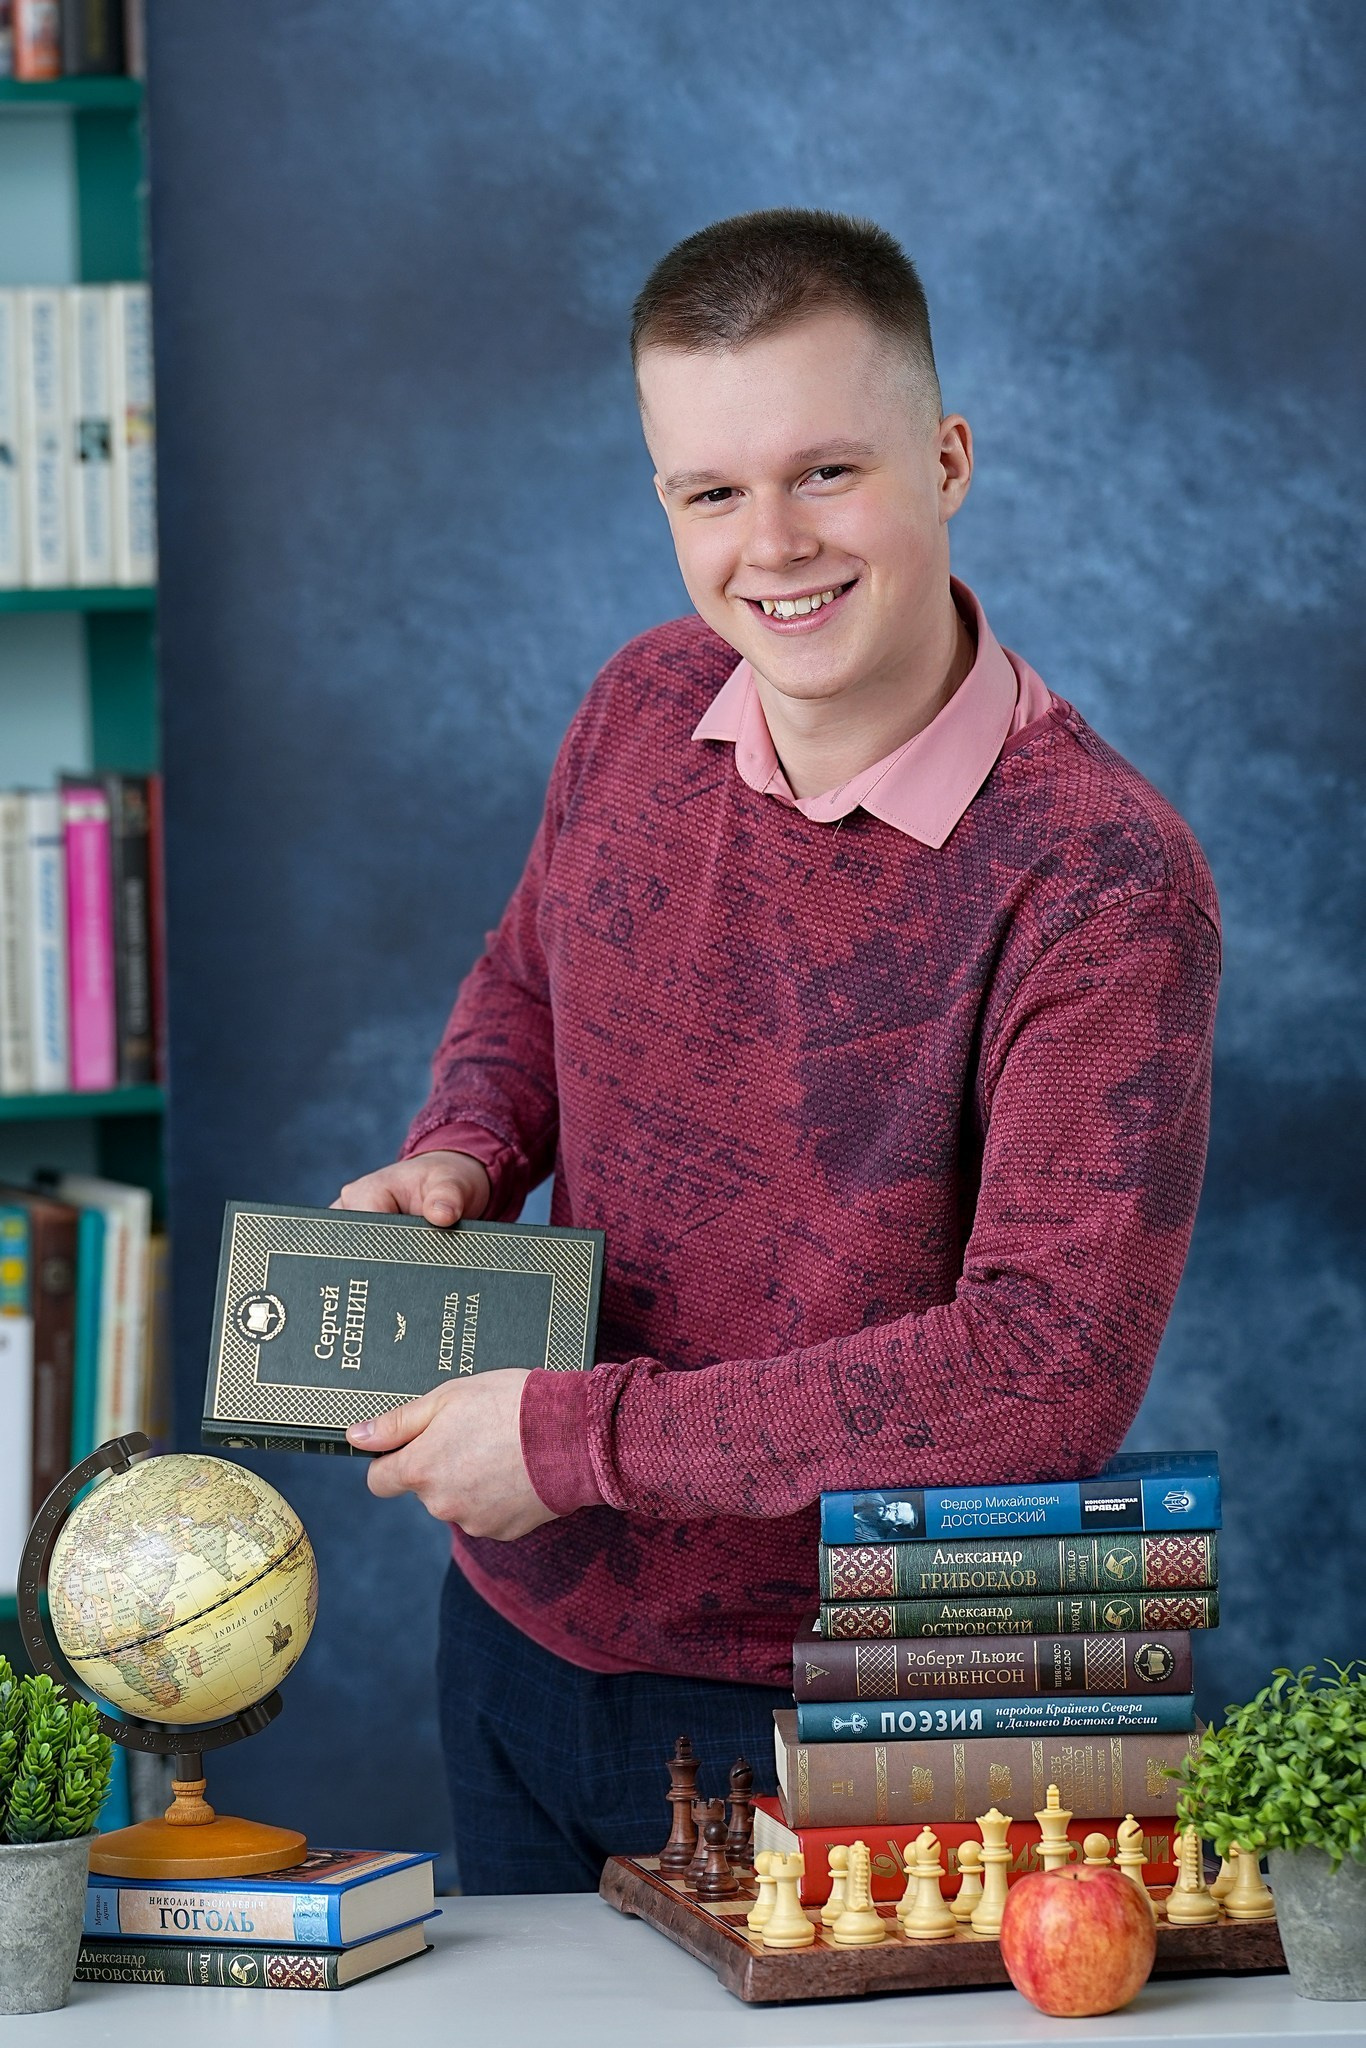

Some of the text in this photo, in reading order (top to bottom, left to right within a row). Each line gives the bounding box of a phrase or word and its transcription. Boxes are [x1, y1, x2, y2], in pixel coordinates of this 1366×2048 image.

[314, 1285, 341, 1359] Сергей
[341, 1279, 369, 1370] ЕСЕНИН
[438, 1292, 460, 1371] ИСПОВЕДЬ
[460, 1292, 480, 1375] ХУЛИГАНА
[940, 1494, 1060, 1512] Федор Михайлович
[1084, 1496, 1138, 1506] КОМСОМОЛЬСКАЯ
[1084, 1503, 1127, 1513] ПРАВДА
[941, 1509, 1046, 1529] ДОСТОЕВСКИЙ
[932, 1548, 1023, 1567] Александр
[920, 1570, 1038, 1590] ГРИБОЕДОВ
[214, 1595, 279, 1639] INDIAN OCEAN
[940, 1604, 1013, 1620] Александр
[921, 1619, 1034, 1637] ОСТРОВСКИЙ
[907, 1650, 1025, 1668] Роберт Льюис
[1053, 1643, 1062, 1688] СОКРОВИЩ
[1063, 1649, 1072, 1681] ОСТРОВ
[907, 1669, 1025, 1686] СТИВЕНСОН
[995, 1702, 1142, 1717] народов Крайнего Севера
[881, 1709, 983, 1734] ПОЭЗИЯ
[996, 1715, 1158, 1730] и Дальнего Востока России
[1061, 1745, 1074, 1811] РУССКОГО
[1074, 1749, 1086, 1808] СЛОВАРЬ
[149, 1896, 265, 1910] НИКОЛАЙ ВАСИЛЬЕВИЧ
[159, 1907, 255, 1933] ГОГОЛЬ
[79, 1949, 146, 1967] Александр
[74, 1966, 166, 1983] СТРОВСКИЙ
